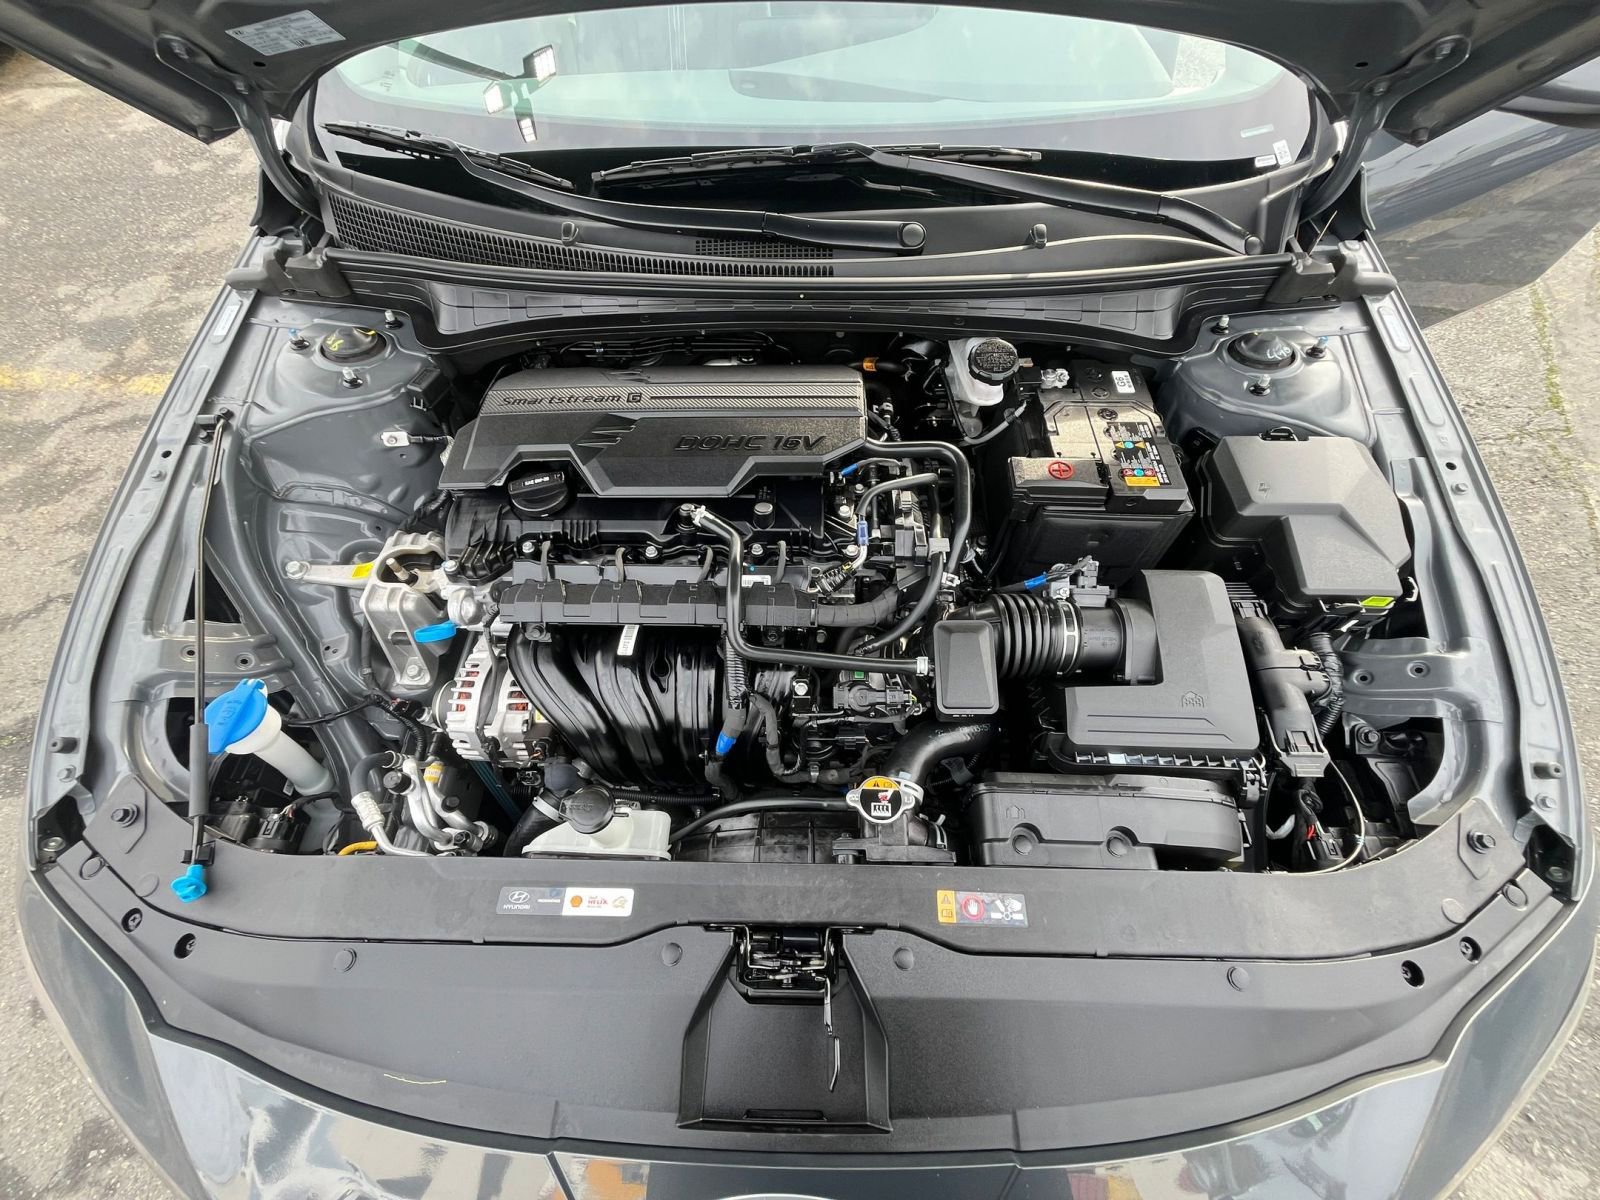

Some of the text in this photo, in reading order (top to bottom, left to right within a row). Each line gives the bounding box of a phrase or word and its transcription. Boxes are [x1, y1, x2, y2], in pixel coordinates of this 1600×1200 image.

[503, 395, 621, 406] Smartstream
[674, 434, 827, 451] DOHC 16V
